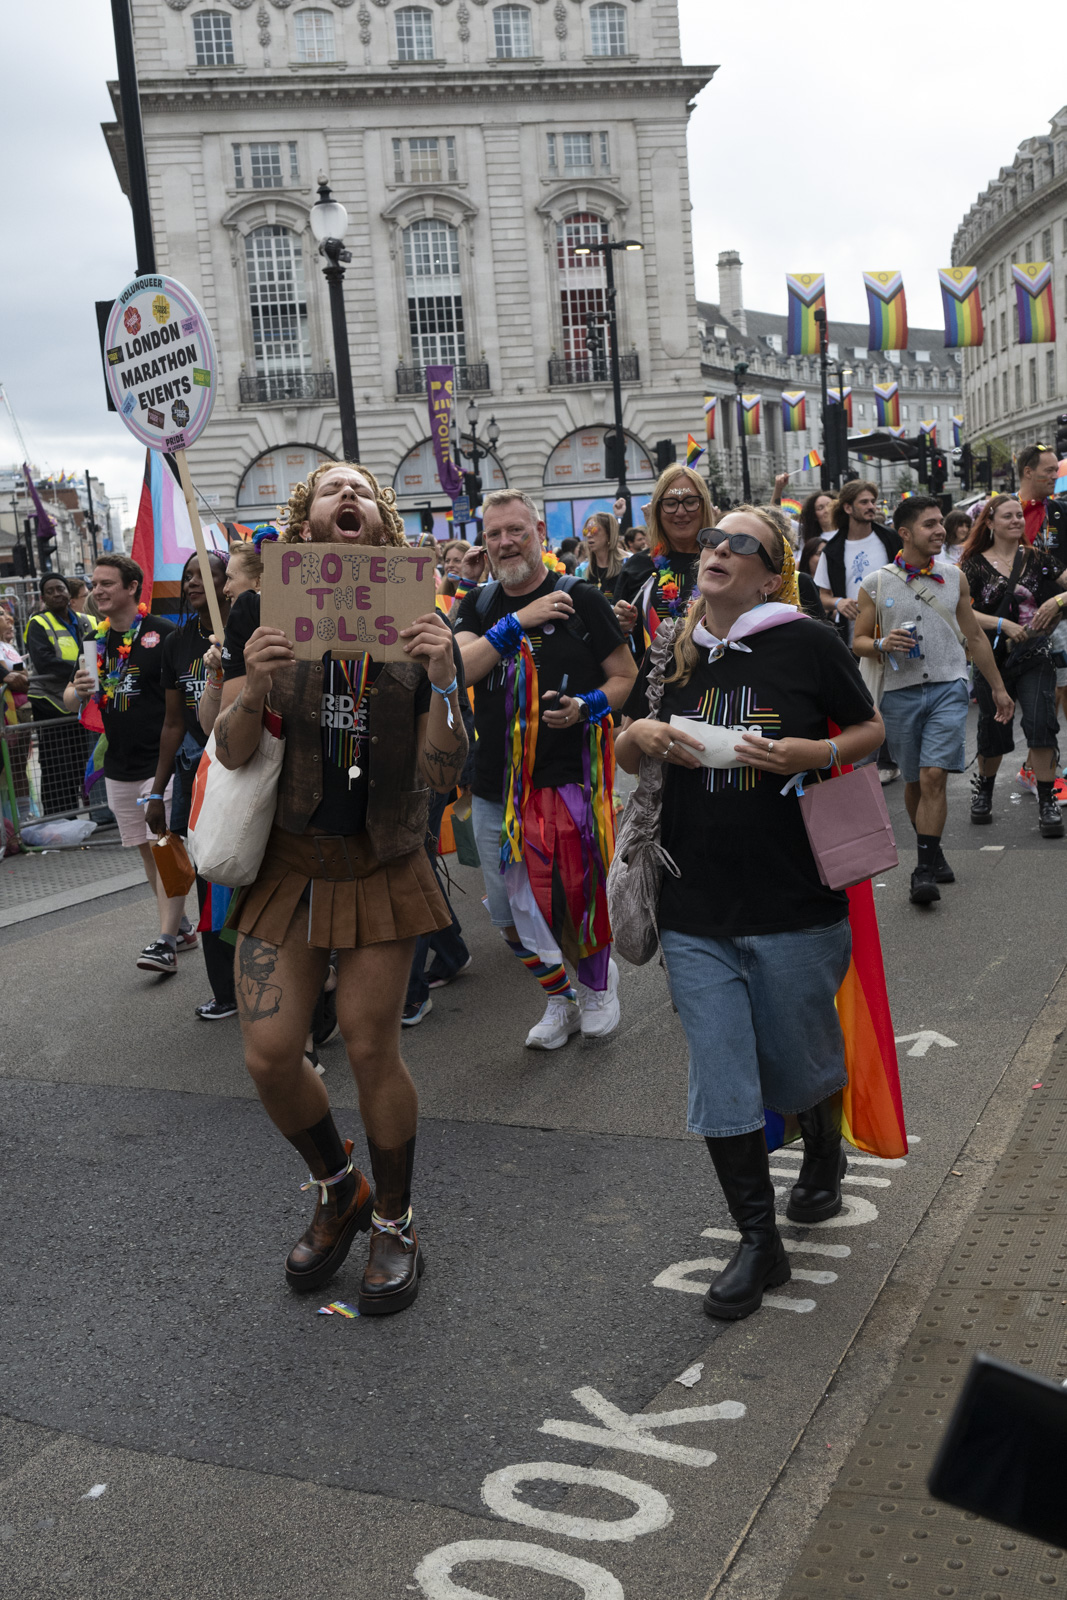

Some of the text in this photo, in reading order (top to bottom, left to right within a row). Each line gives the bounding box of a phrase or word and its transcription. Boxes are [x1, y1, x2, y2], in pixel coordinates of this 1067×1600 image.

[120, 278, 162, 304] VOLUNQUEER
[125, 322, 180, 359] LONDON
[120, 344, 198, 389] MARATHON
[138, 376, 191, 410] EVENTS
[281, 550, 432, 585] PROTECT
[306, 586, 372, 610] THE
[295, 616, 398, 645] DOLLS
